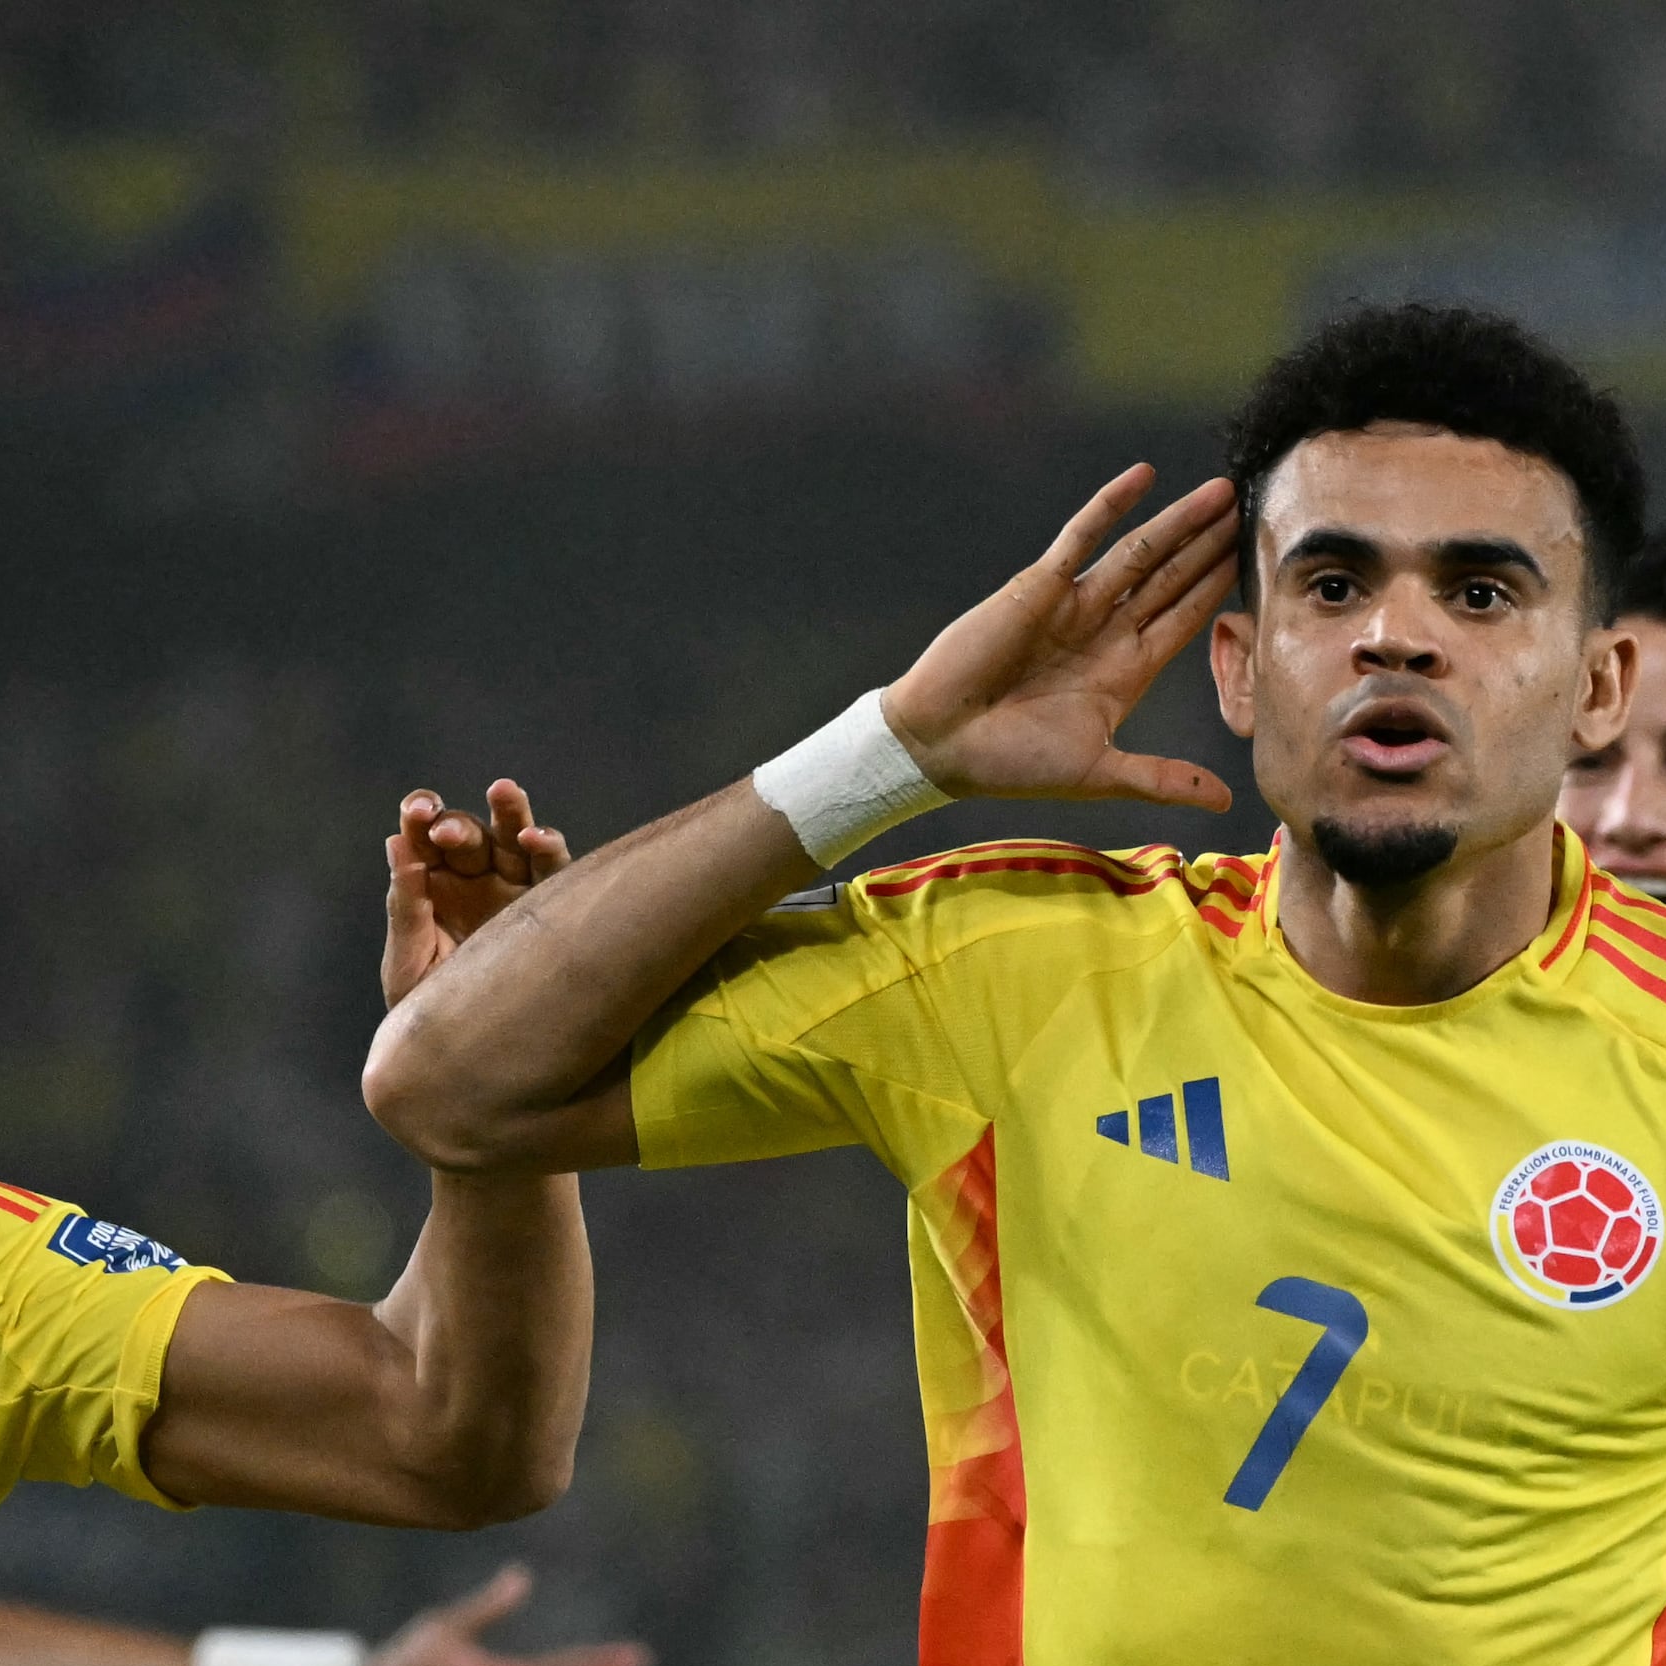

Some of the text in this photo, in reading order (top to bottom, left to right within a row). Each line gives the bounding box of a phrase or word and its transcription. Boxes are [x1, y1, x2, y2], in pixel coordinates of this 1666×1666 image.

[1552, 1146, 1627, 1177] COLOMBIANA
[1627, 1174, 1642, 1190] DE
[1179, 1349, 1473, 1438] CATPUL
[1223, 1276, 1368, 1512] 7
